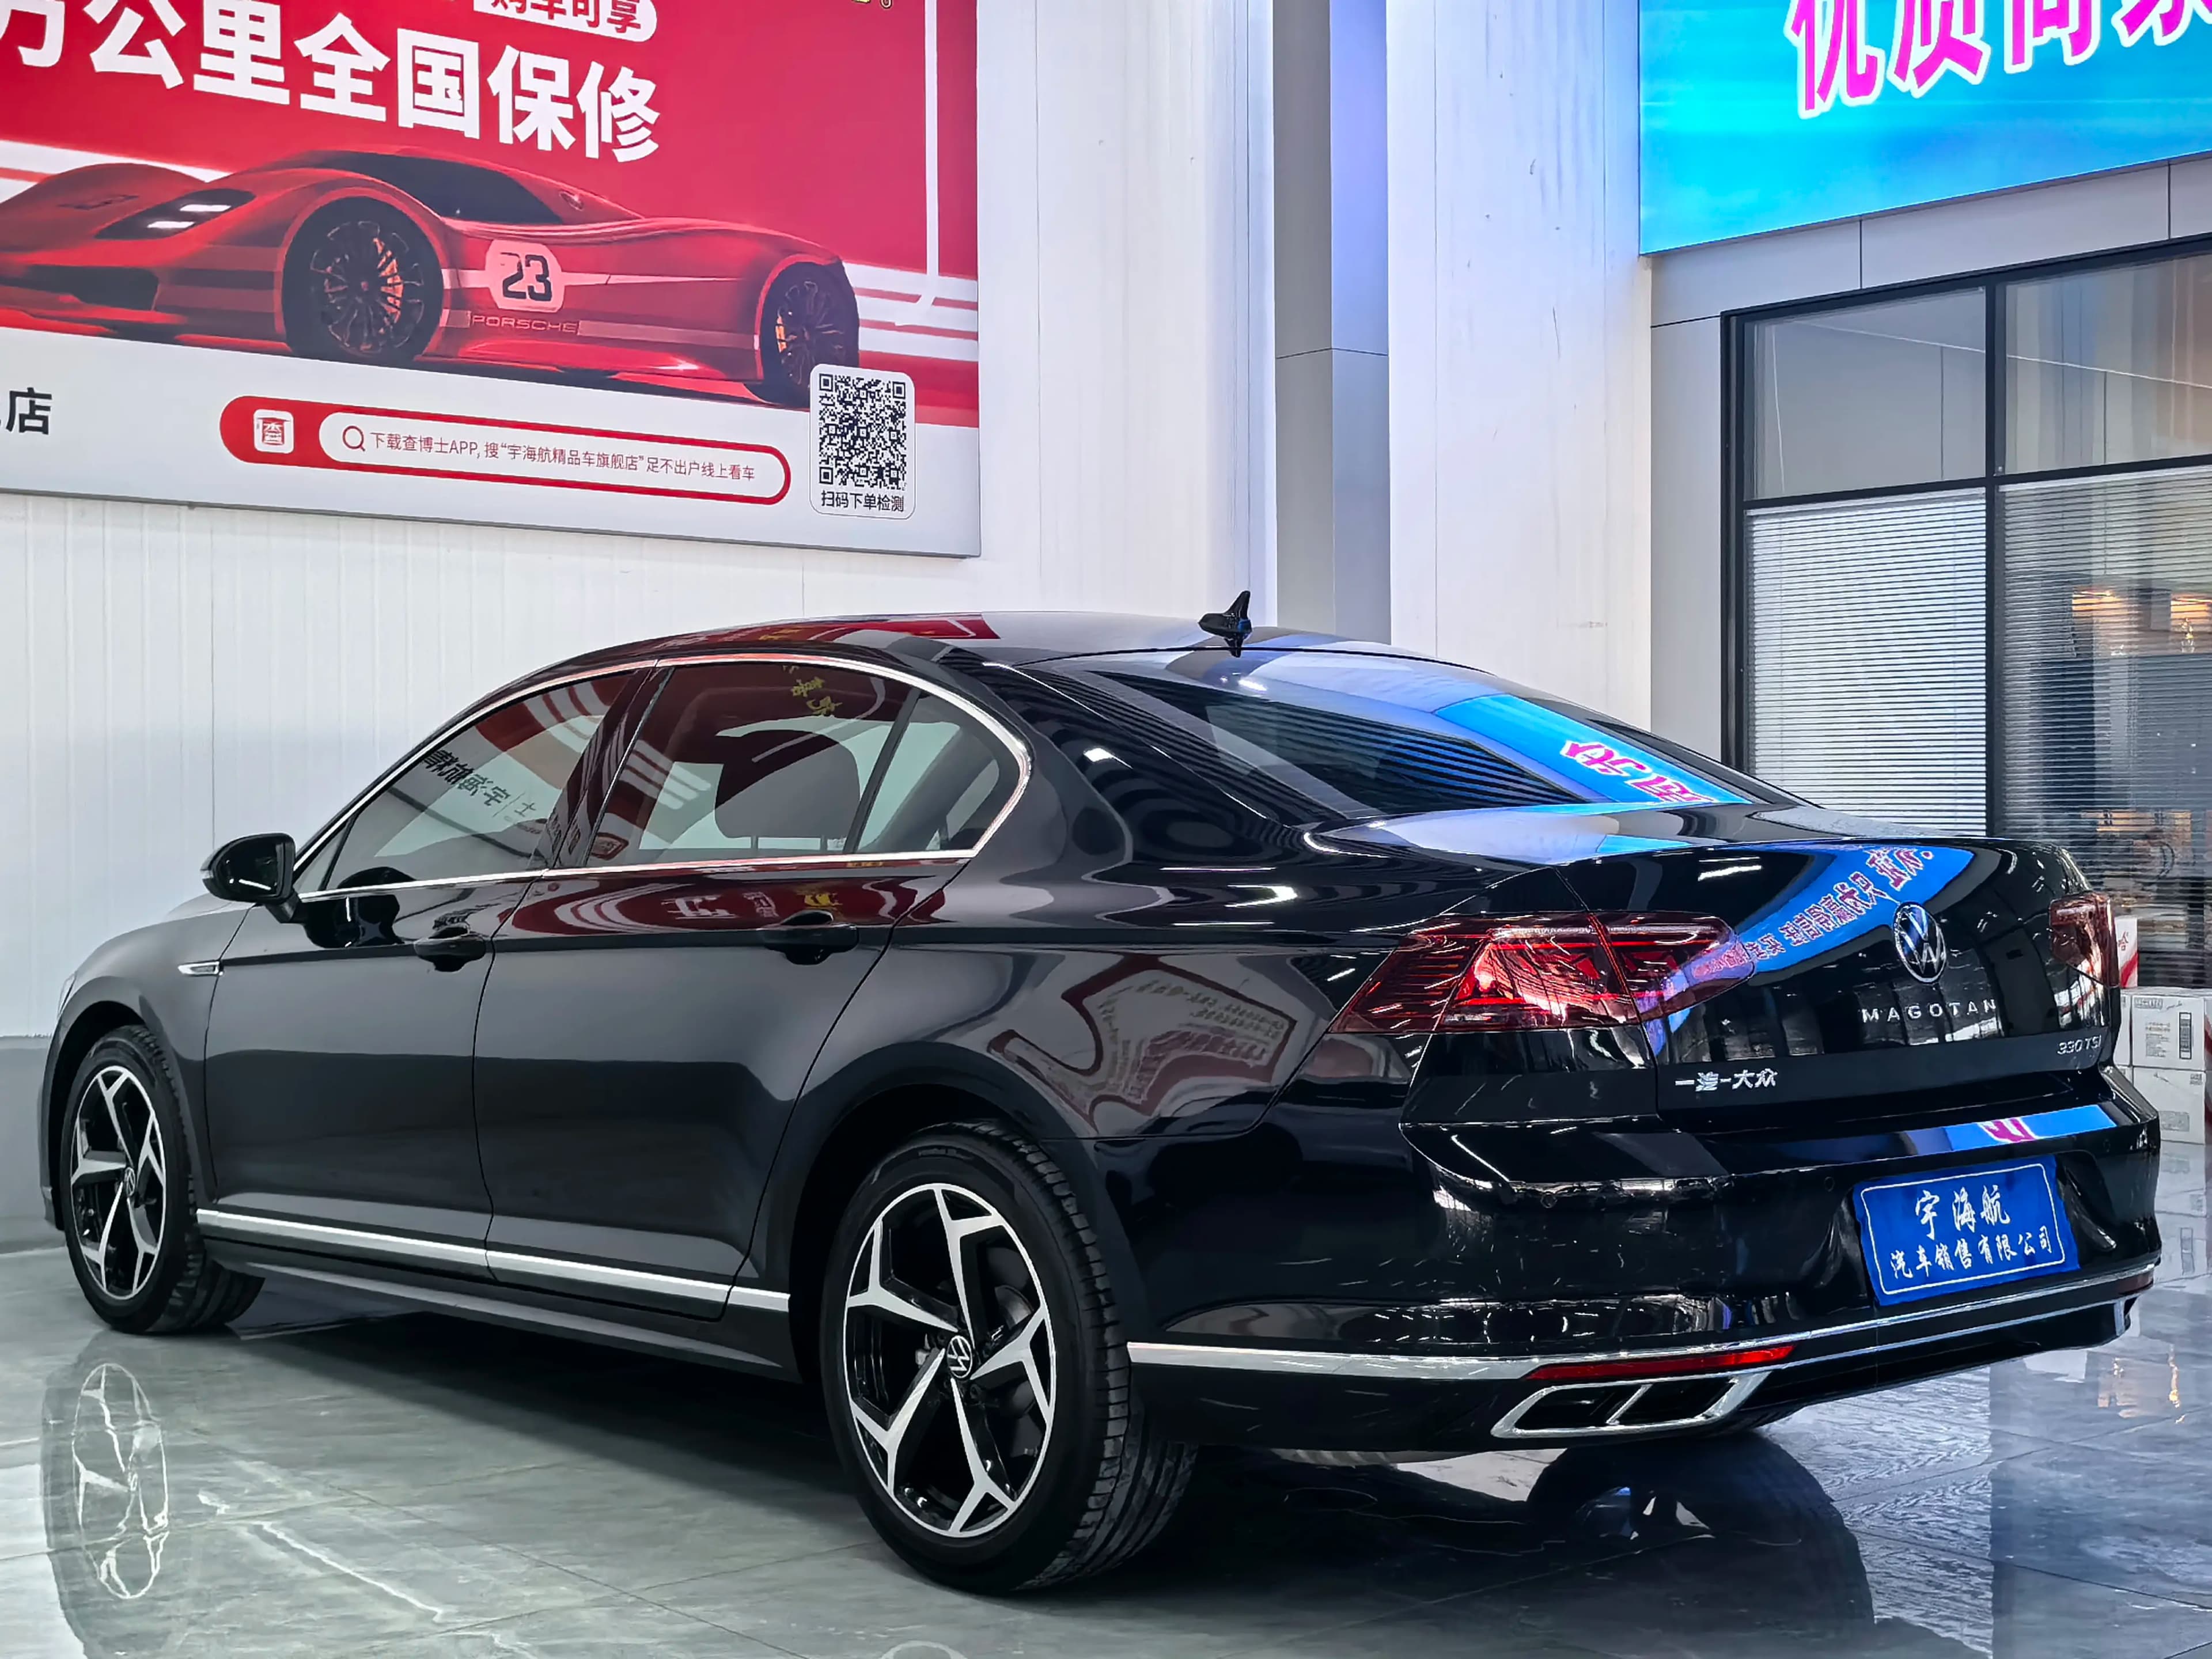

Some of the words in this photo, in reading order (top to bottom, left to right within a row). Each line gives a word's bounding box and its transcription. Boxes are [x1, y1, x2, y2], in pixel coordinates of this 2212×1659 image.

[500, 252, 552, 302] 23
[472, 315, 576, 332] PORSCHE
[821, 490, 904, 512] 扫码下单检测
[1861, 999, 1996, 1023] MAGOTAN
[1915, 1184, 2010, 1240] 宇海航
[1891, 1226, 2052, 1279] 汽车销售有限公司
